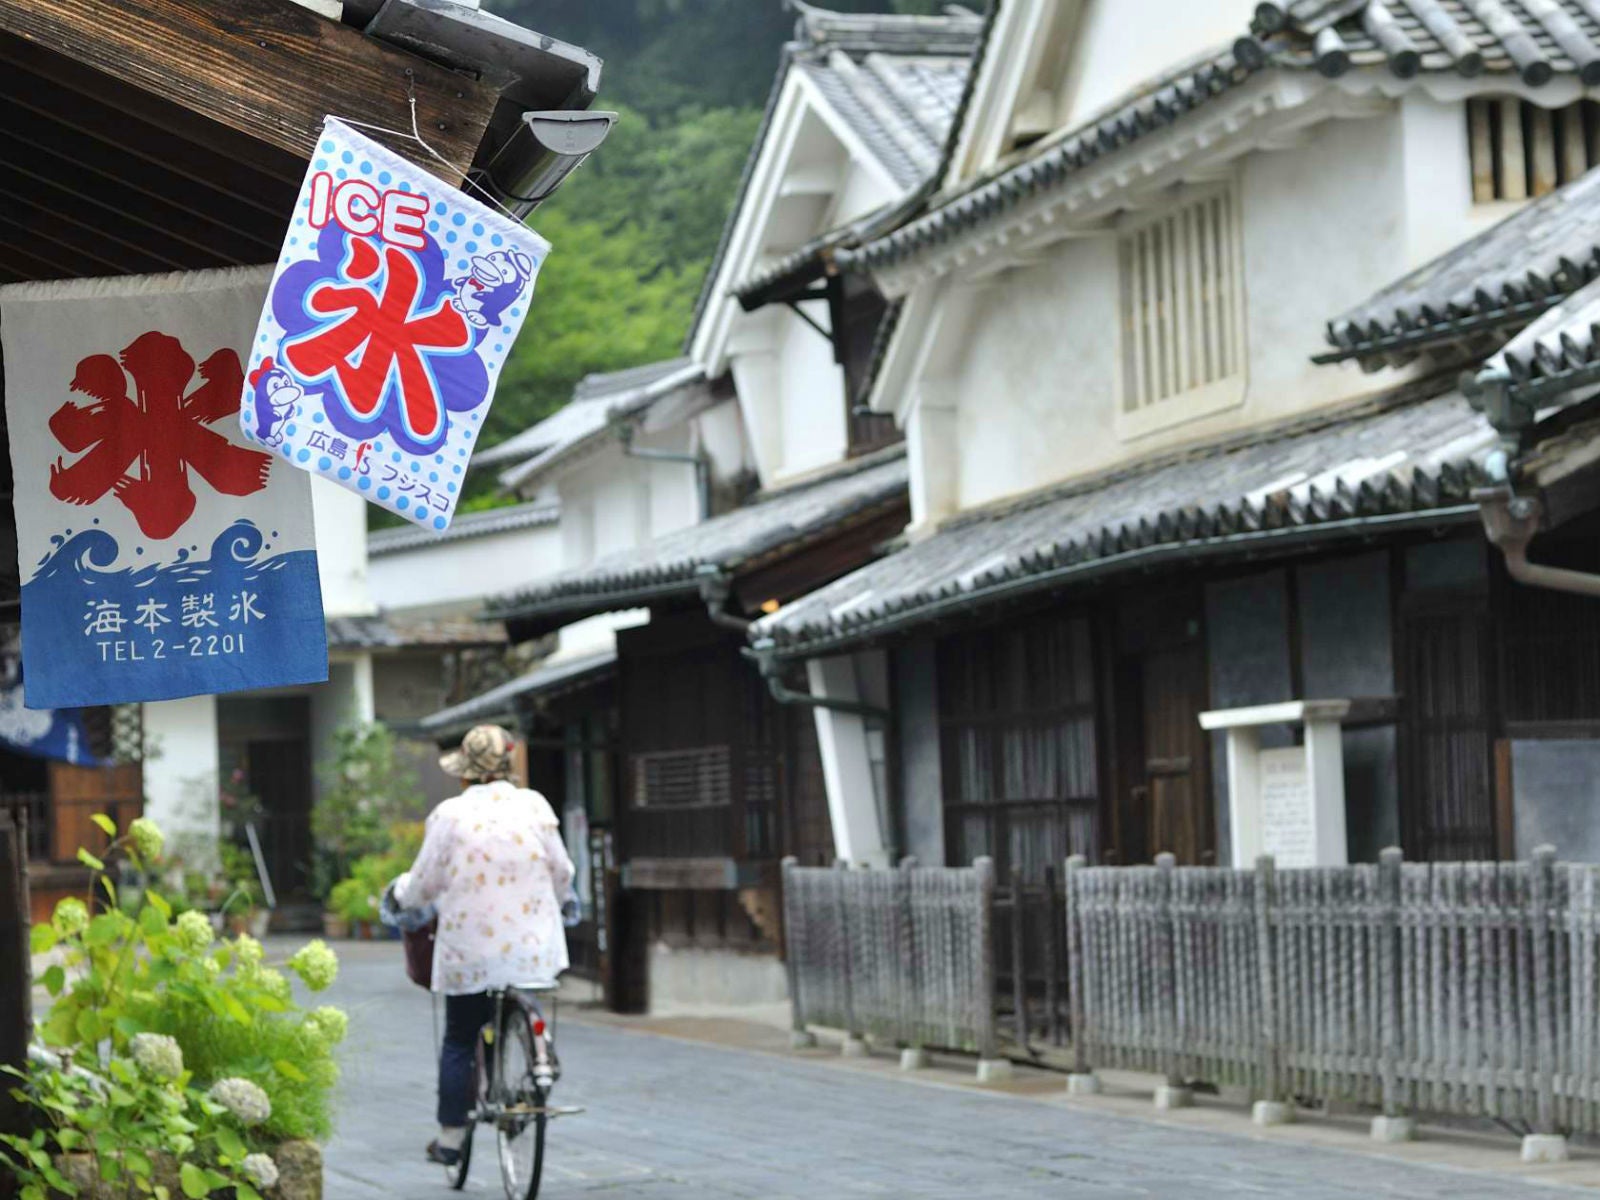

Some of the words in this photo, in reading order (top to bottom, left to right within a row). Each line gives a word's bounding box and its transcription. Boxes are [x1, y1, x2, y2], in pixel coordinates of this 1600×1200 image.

[308, 171, 430, 253] ICE
[284, 235, 470, 438] 氷
[48, 330, 272, 540] 氷
[305, 430, 349, 461] 広島
[381, 464, 450, 512] フジスコ
[83, 590, 267, 637] 海本製氷
[96, 640, 145, 662] TEL
[151, 633, 245, 660] 2-2201
